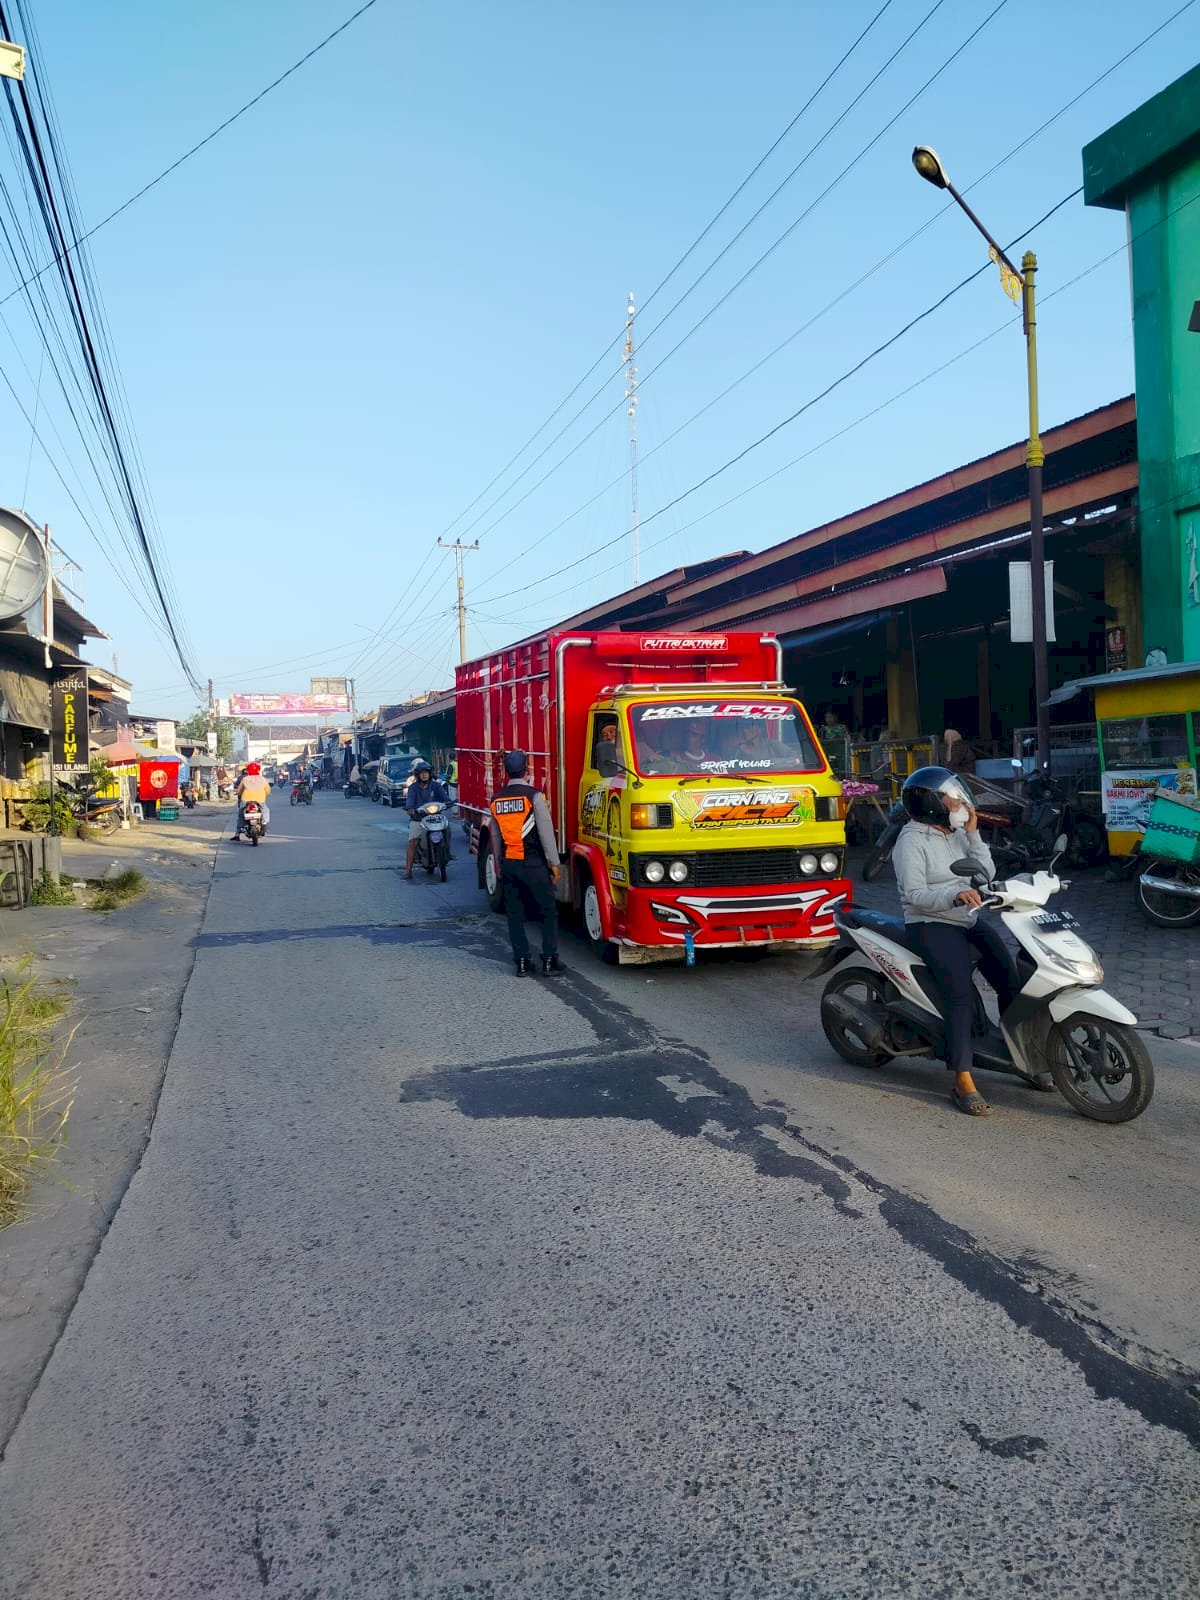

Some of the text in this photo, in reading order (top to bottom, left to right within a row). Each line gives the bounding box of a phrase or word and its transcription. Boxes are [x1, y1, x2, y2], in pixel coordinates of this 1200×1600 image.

[64, 694, 77, 763] PARFUME
[64, 763, 88, 771] ULANG
[701, 759, 771, 770] SPIRIT YOUNG
[702, 791, 789, 807] CORN AND
[496, 800, 524, 814] DISHUB
[694, 802, 799, 822] RICE
[695, 816, 800, 828] TRANSPORTATION
